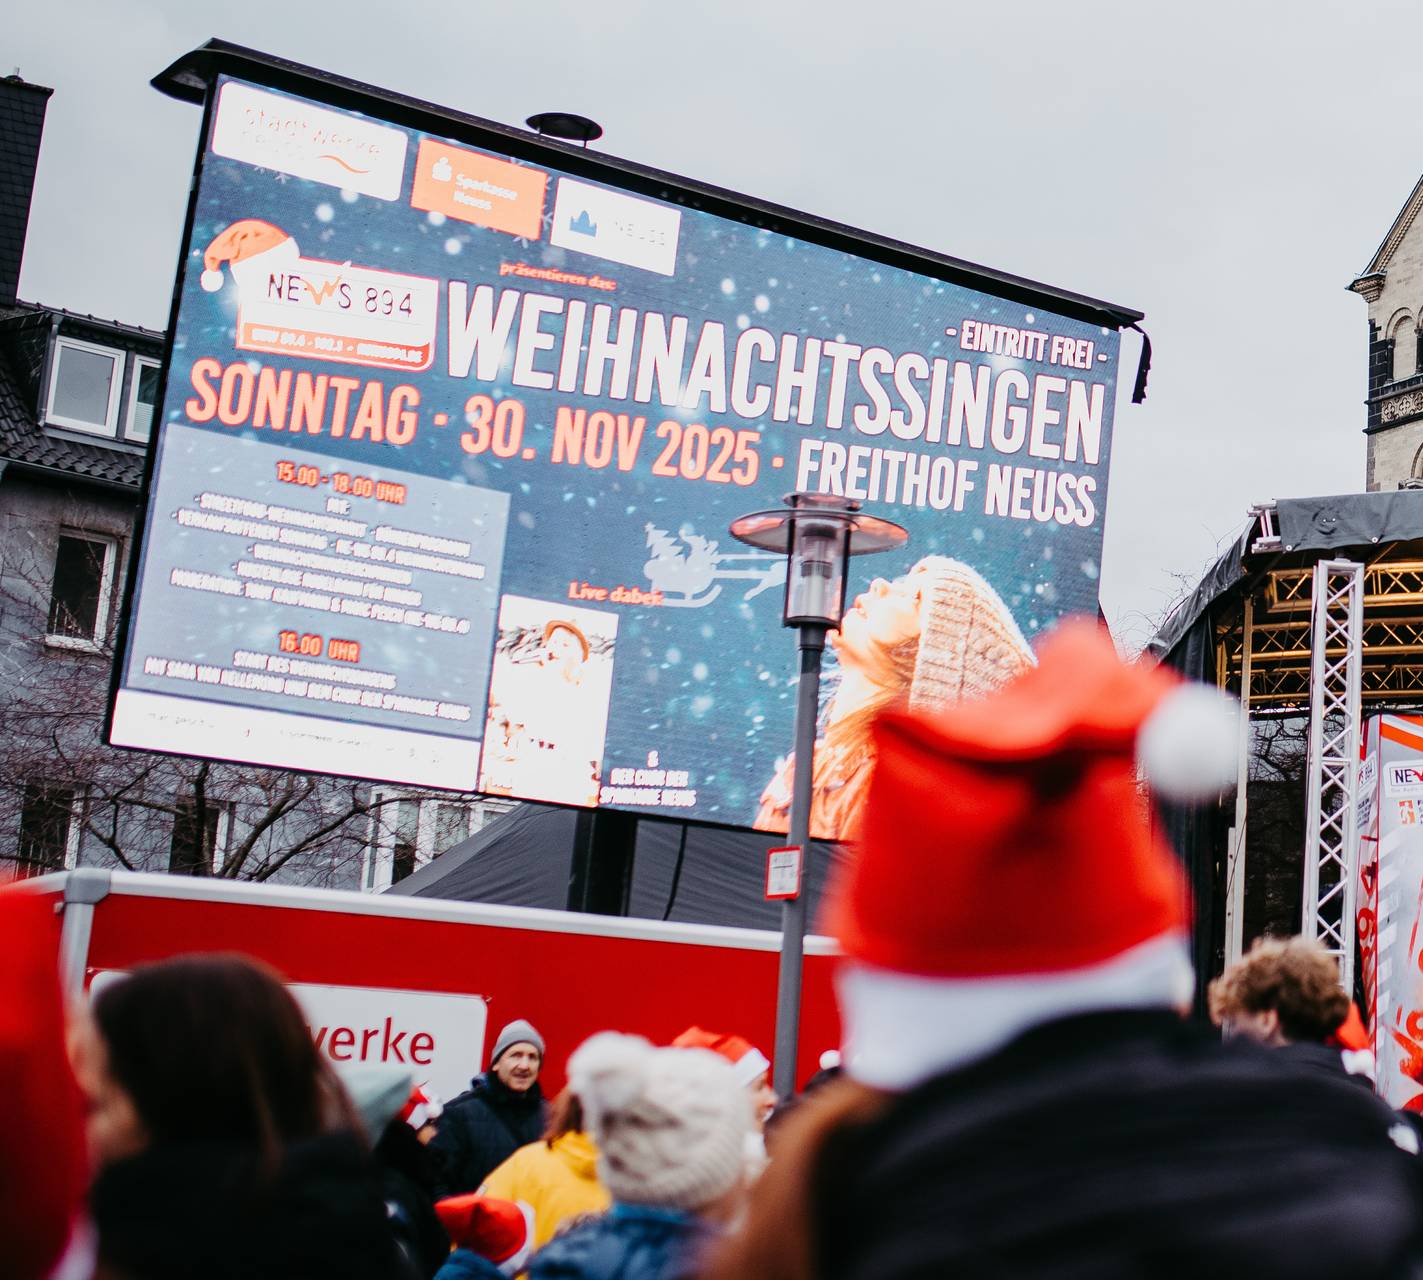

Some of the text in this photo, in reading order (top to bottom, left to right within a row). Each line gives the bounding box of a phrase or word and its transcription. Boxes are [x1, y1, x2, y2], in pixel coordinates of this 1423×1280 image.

[500, 261, 587, 285] präsentieren
[959, 319, 1095, 370] EINTRITT FREI
[448, 280, 1106, 466] WEIHNACHTSSINGEN
[185, 358, 761, 487] SONNTAG 30. NOV 2025
[276, 461, 407, 505] 15.00 18.00 UHR
[795, 437, 1098, 528] FREITHOF NEUSS
[568, 579, 608, 601] Live
[278, 630, 361, 664] 16.00 UHR
